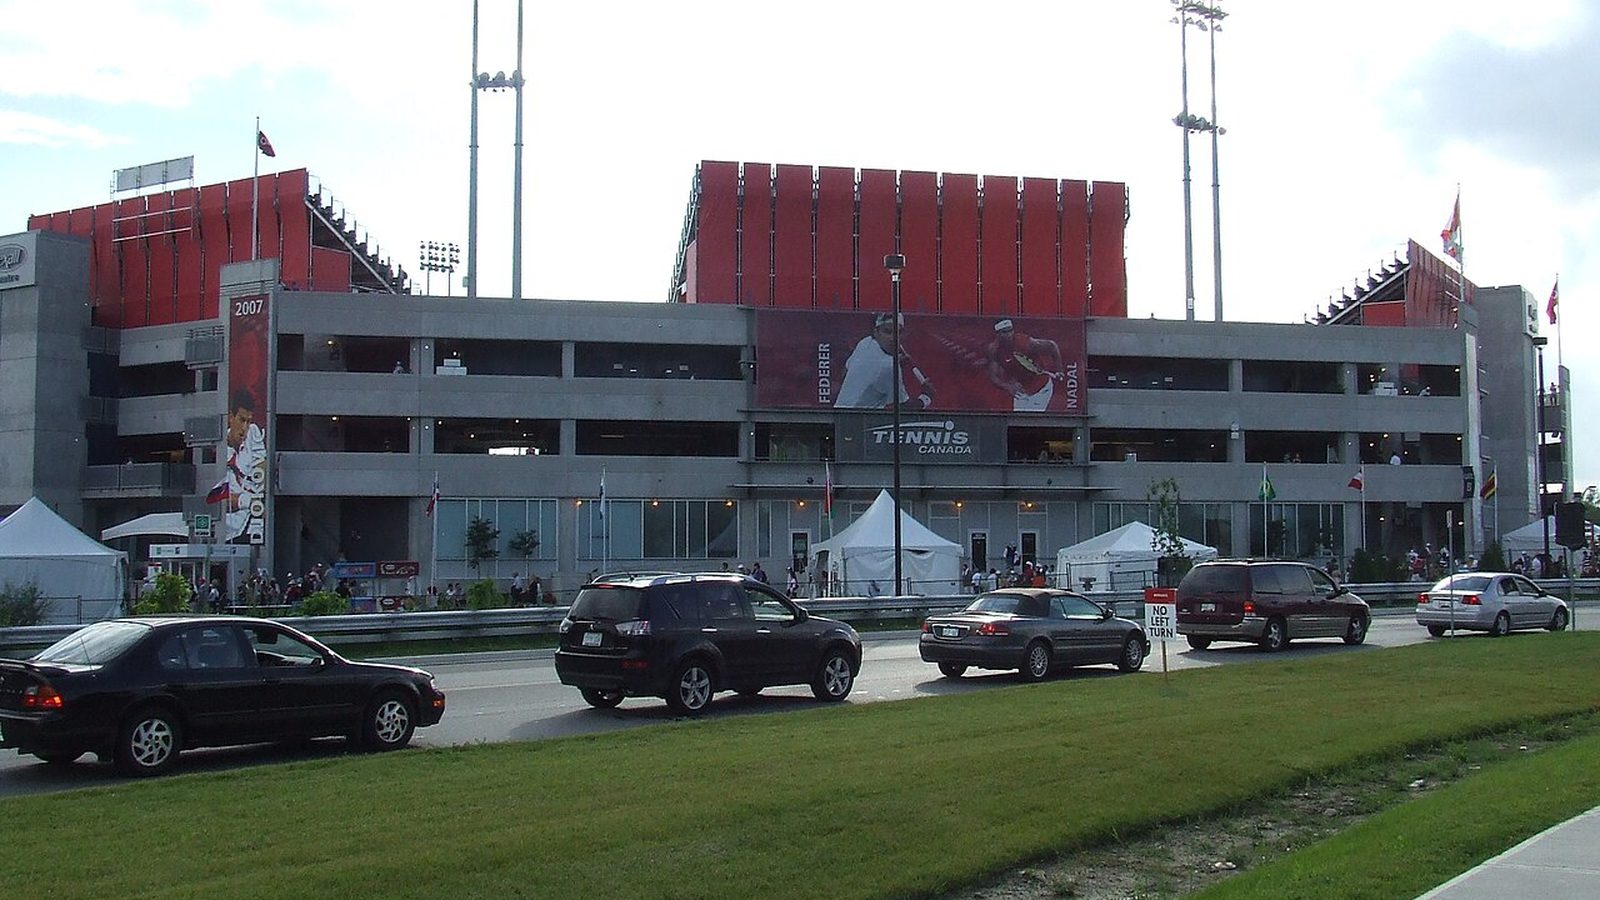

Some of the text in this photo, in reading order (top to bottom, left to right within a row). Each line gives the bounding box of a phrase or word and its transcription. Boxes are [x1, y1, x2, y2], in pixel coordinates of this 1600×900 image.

[235, 300, 264, 316] 2007
[818, 343, 831, 403] FEDERER
[1066, 362, 1078, 408] NADAL
[873, 428, 969, 444] TENNIS
[918, 445, 972, 454] CANADA
[249, 427, 265, 544] DJOKOVIC
[1152, 605, 1168, 616] NO
[1150, 616, 1170, 627] LEFT
[1149, 627, 1174, 638] TURN
